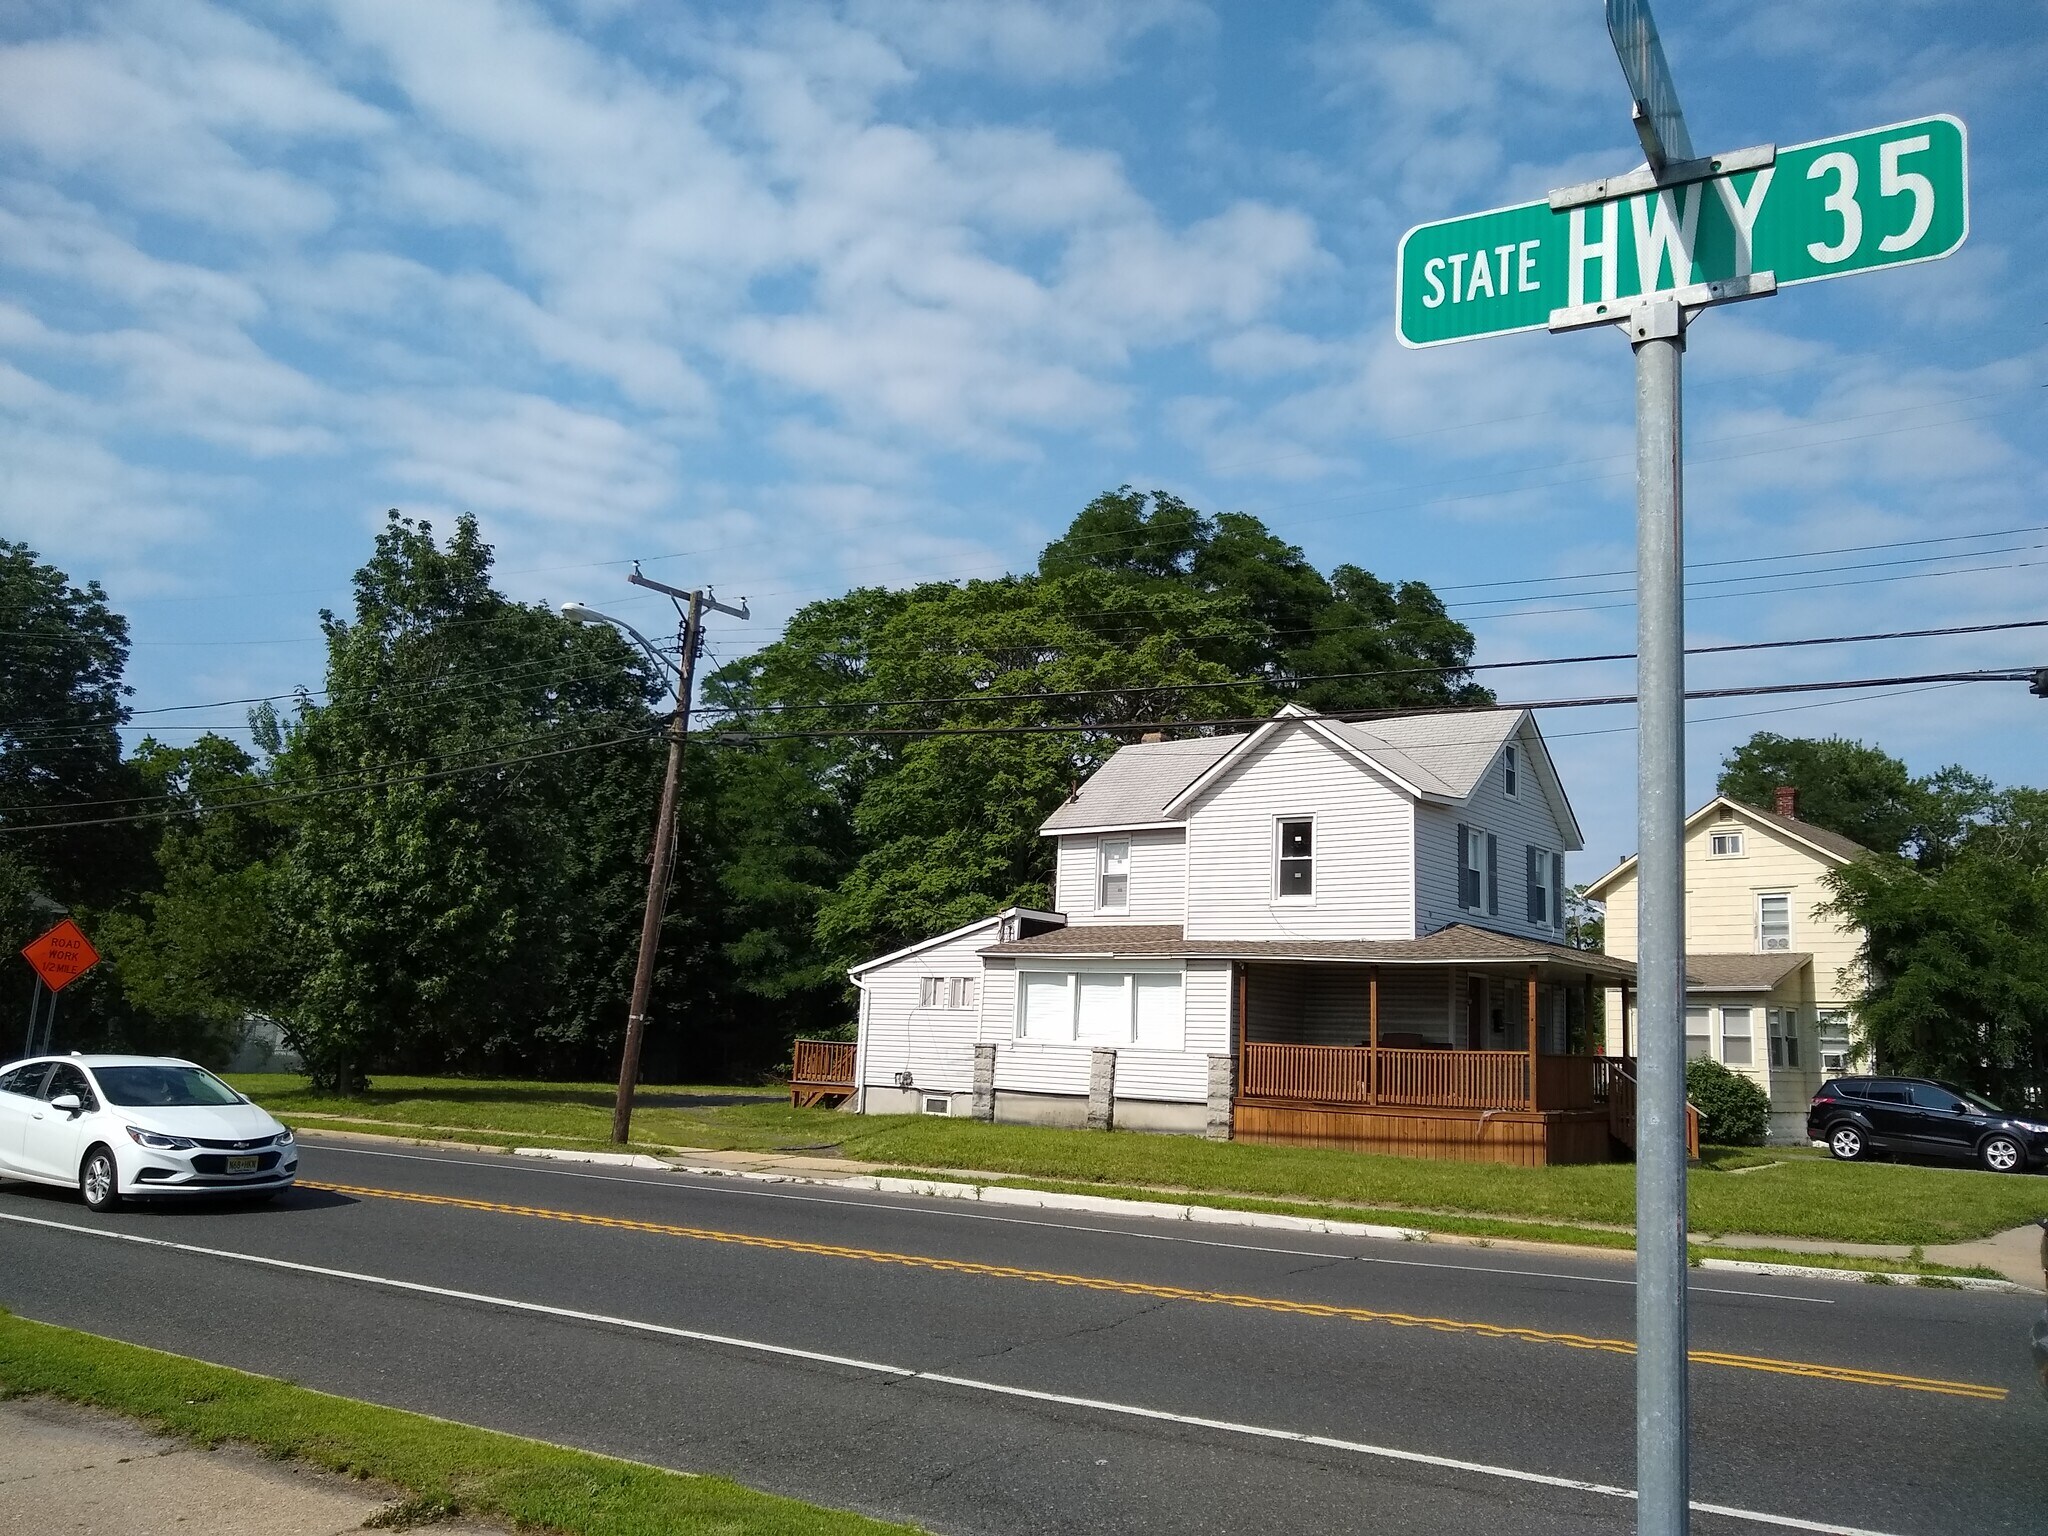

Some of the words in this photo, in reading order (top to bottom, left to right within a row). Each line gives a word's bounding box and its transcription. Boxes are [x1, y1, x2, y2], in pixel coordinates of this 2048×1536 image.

[1422, 238, 1541, 309] STATE
[1568, 166, 1776, 307] HWY
[1805, 134, 1936, 264] 35
[51, 937, 81, 949] ROAD
[48, 949, 79, 961] WORK
[56, 963, 79, 975] MILE
